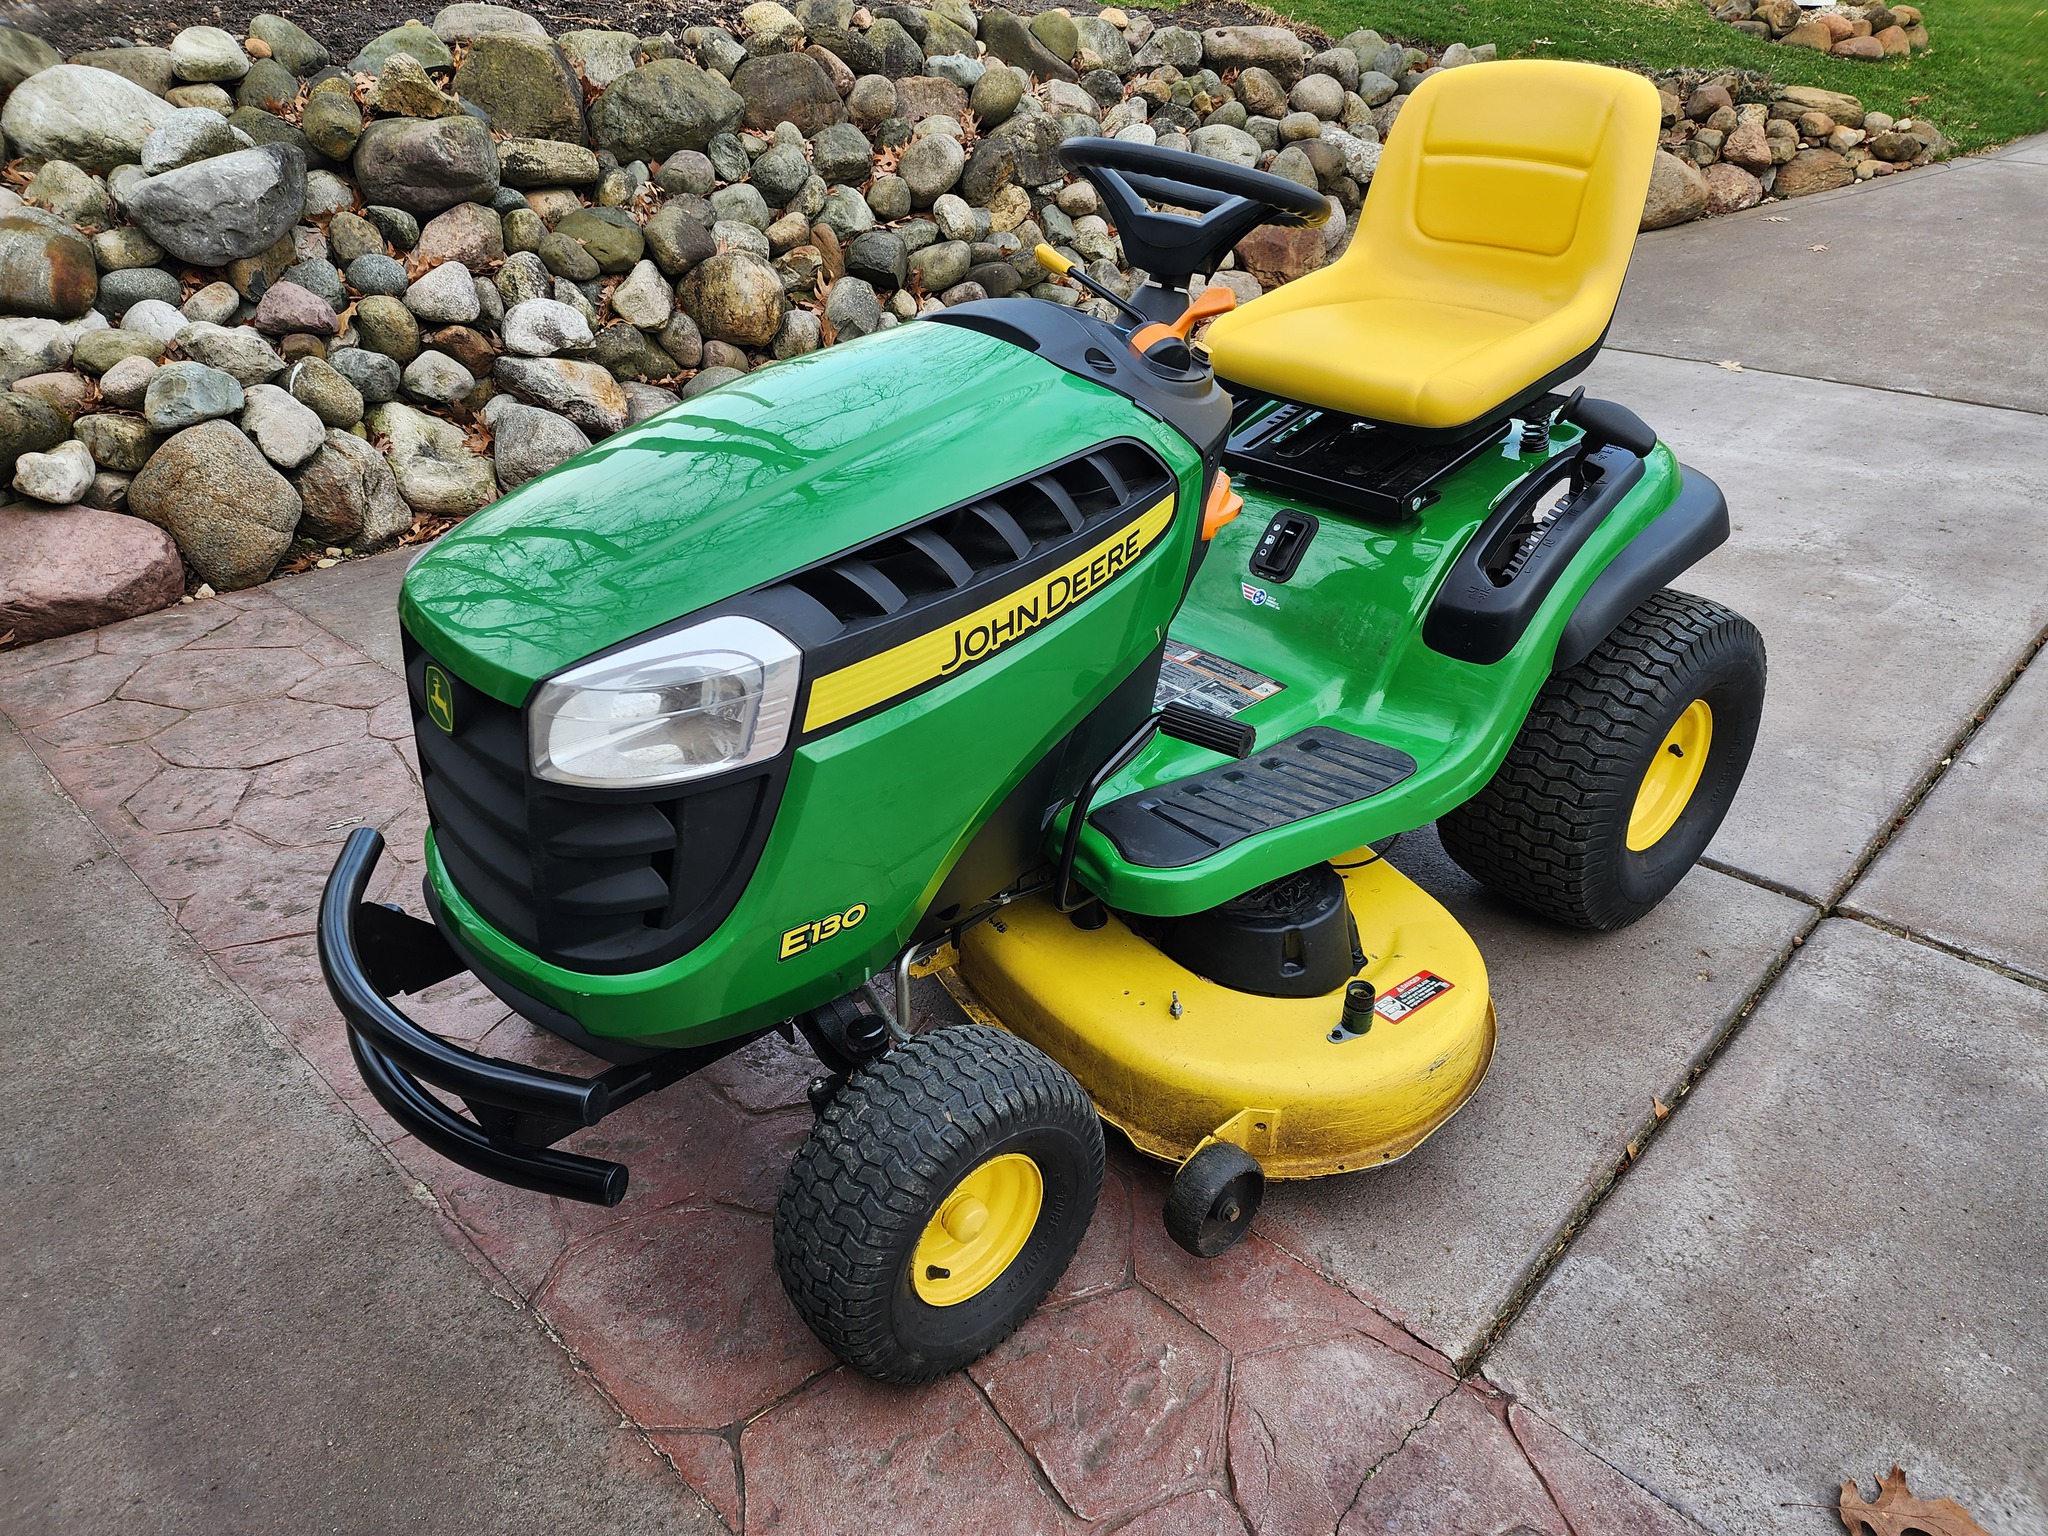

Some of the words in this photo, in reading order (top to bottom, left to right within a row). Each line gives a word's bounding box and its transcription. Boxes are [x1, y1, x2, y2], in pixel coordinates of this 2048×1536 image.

[942, 597, 1039, 671] JOHN
[1046, 528, 1141, 610] DEERE
[779, 903, 868, 961] E130
